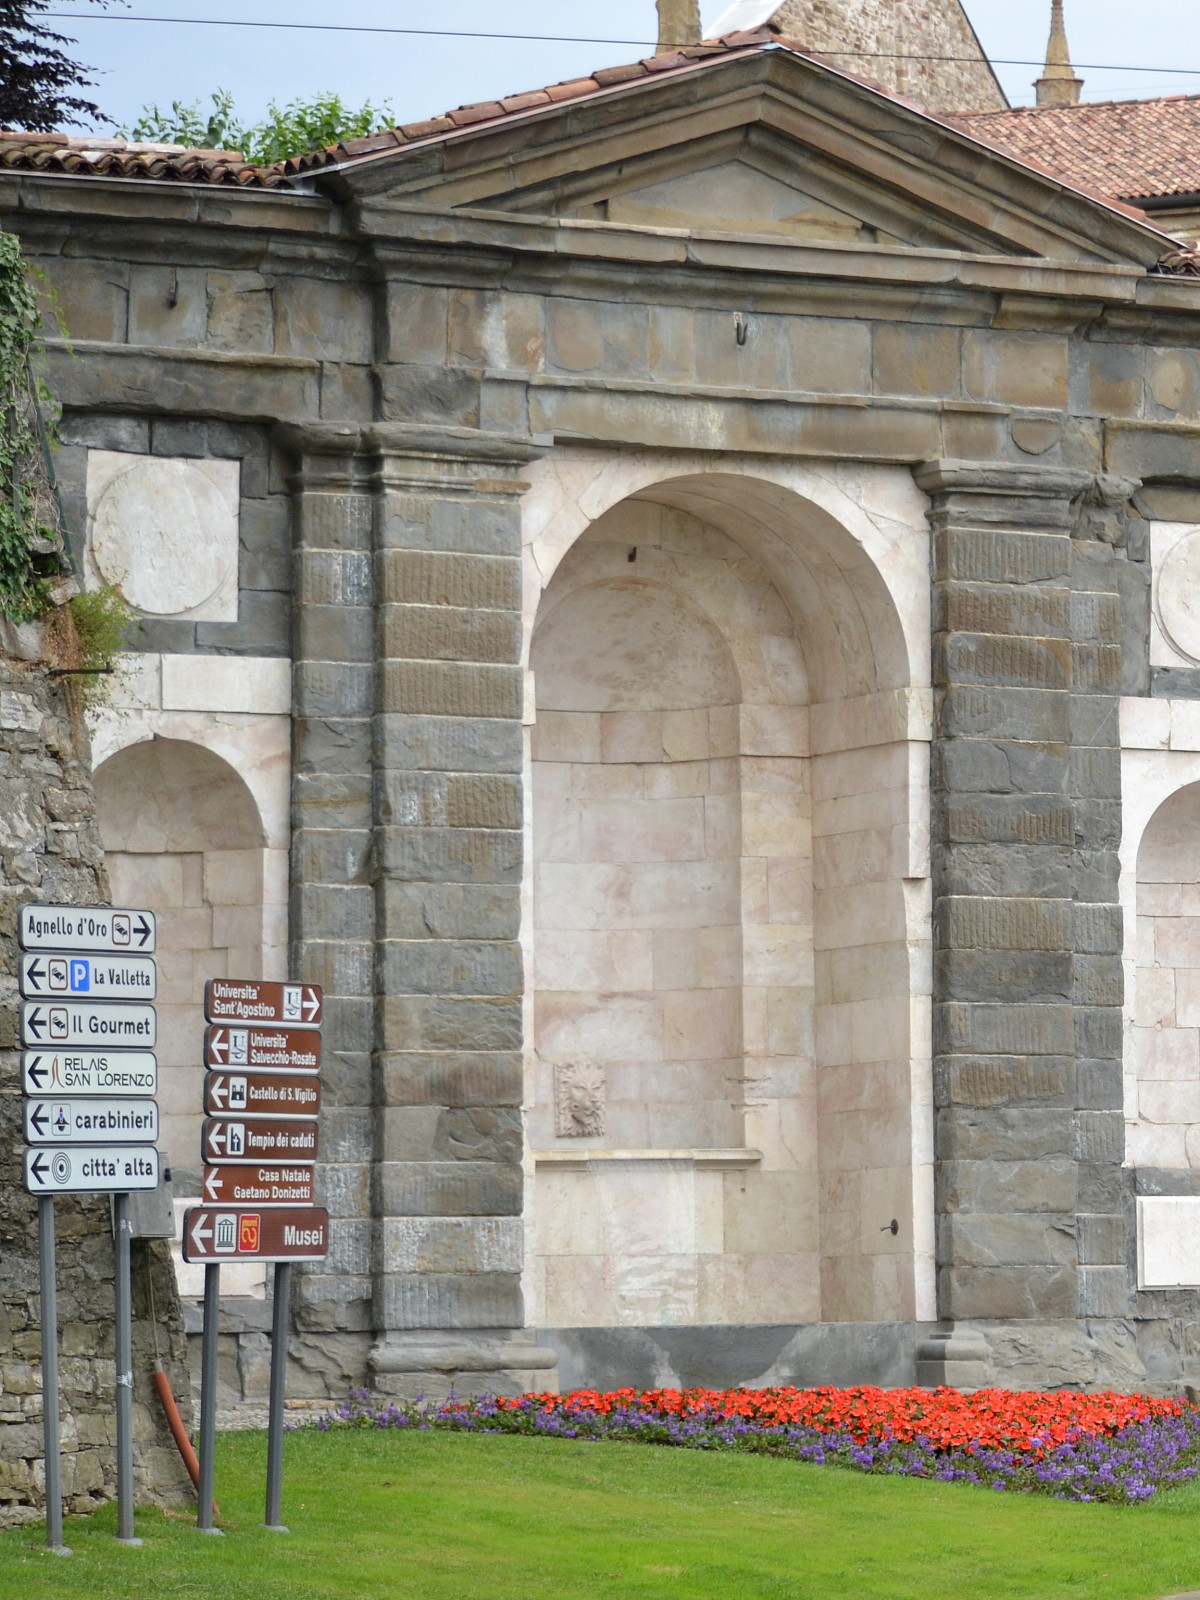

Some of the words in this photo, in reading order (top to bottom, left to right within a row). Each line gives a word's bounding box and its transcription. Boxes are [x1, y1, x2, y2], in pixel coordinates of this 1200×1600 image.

[28, 915, 73, 938] Agnello
[77, 918, 107, 937] d'Oro
[74, 963, 87, 988] P
[94, 967, 105, 985] La
[109, 968, 151, 986] Valletta
[213, 1000, 276, 1018] Sant'Agostino
[73, 1014, 83, 1033] Il
[88, 1015, 150, 1035] Gourmet
[64, 1057, 108, 1071] RELAIS
[250, 1049, 317, 1066] Salvecchio-Rosate
[64, 1073, 91, 1086] SAN
[97, 1073, 154, 1087] LORENZO
[250, 1086, 278, 1100] Castello
[279, 1087, 287, 1101] di
[75, 1110, 153, 1129] carabinieri
[248, 1131, 275, 1150] Tempio
[276, 1132, 288, 1147] dei
[291, 1133, 315, 1148] caduti
[82, 1158, 120, 1177] citta'
[124, 1157, 153, 1176] alta
[258, 1168, 280, 1182] Casa
[282, 1169, 310, 1182] Natale
[233, 1186, 270, 1199] Gaetano
[272, 1186, 310, 1199] Donizetti
[284, 1225, 323, 1246] Musei
